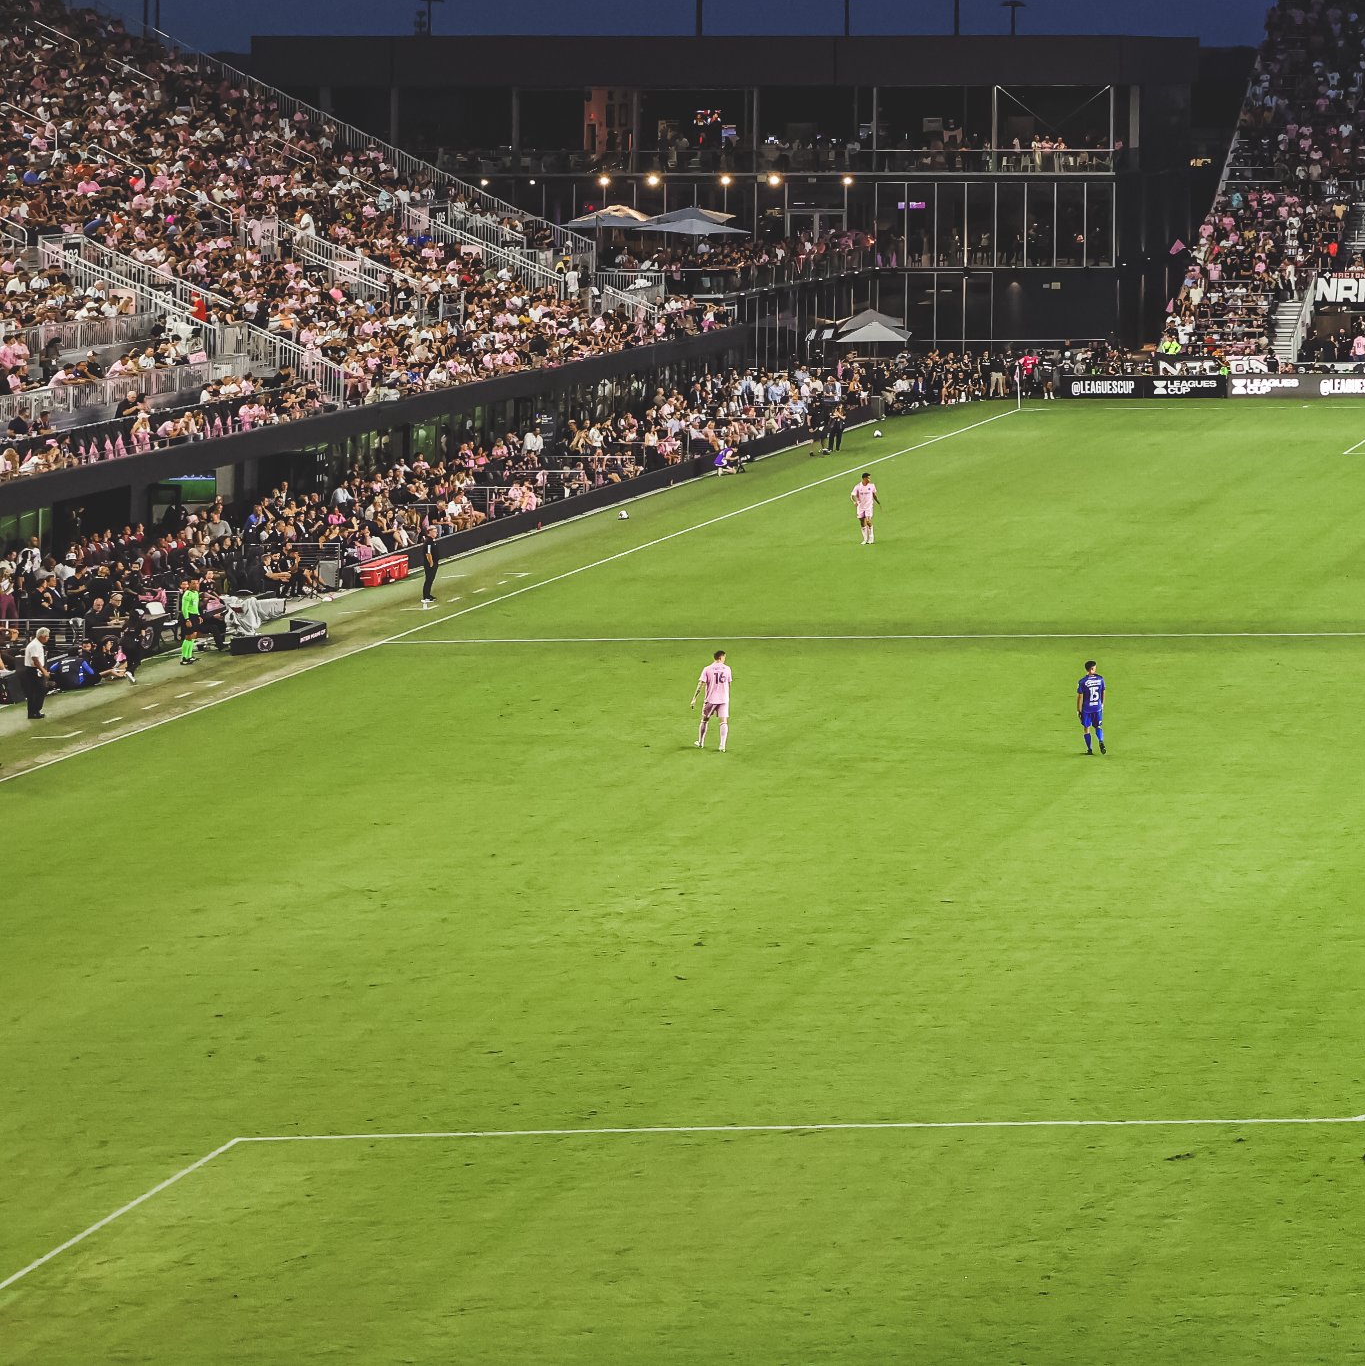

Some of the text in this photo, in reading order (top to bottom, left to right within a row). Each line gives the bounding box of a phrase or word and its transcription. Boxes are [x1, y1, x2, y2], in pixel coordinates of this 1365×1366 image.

[1071, 380, 1135, 396] @LEAGUESCUP
[1167, 380, 1218, 388] LEAGUES
[1246, 378, 1300, 388] LEAGUES
[1167, 387, 1191, 395] CUP
[1246, 386, 1272, 395] CUP
[713, 672, 726, 685] 16
[1089, 686, 1099, 701] 15
